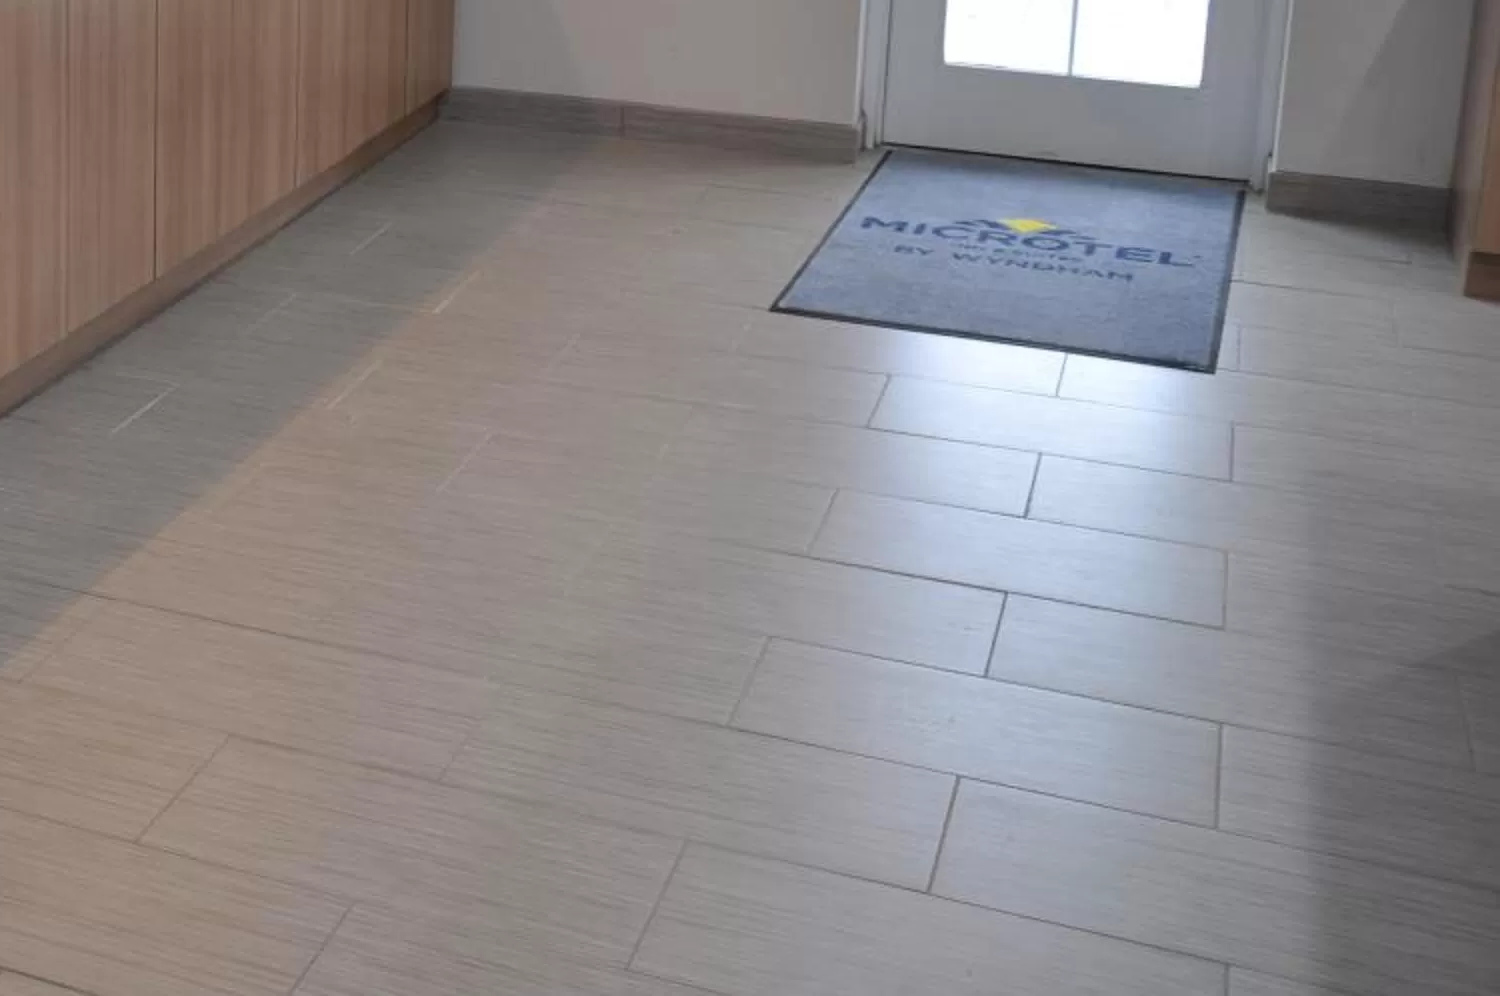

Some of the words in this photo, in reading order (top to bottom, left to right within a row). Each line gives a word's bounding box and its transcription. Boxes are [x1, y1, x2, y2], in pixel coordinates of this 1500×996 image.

[860, 216, 1194, 268] MICROTEL
[894, 244, 935, 255] BY
[953, 253, 1133, 282] WYNDHAM
